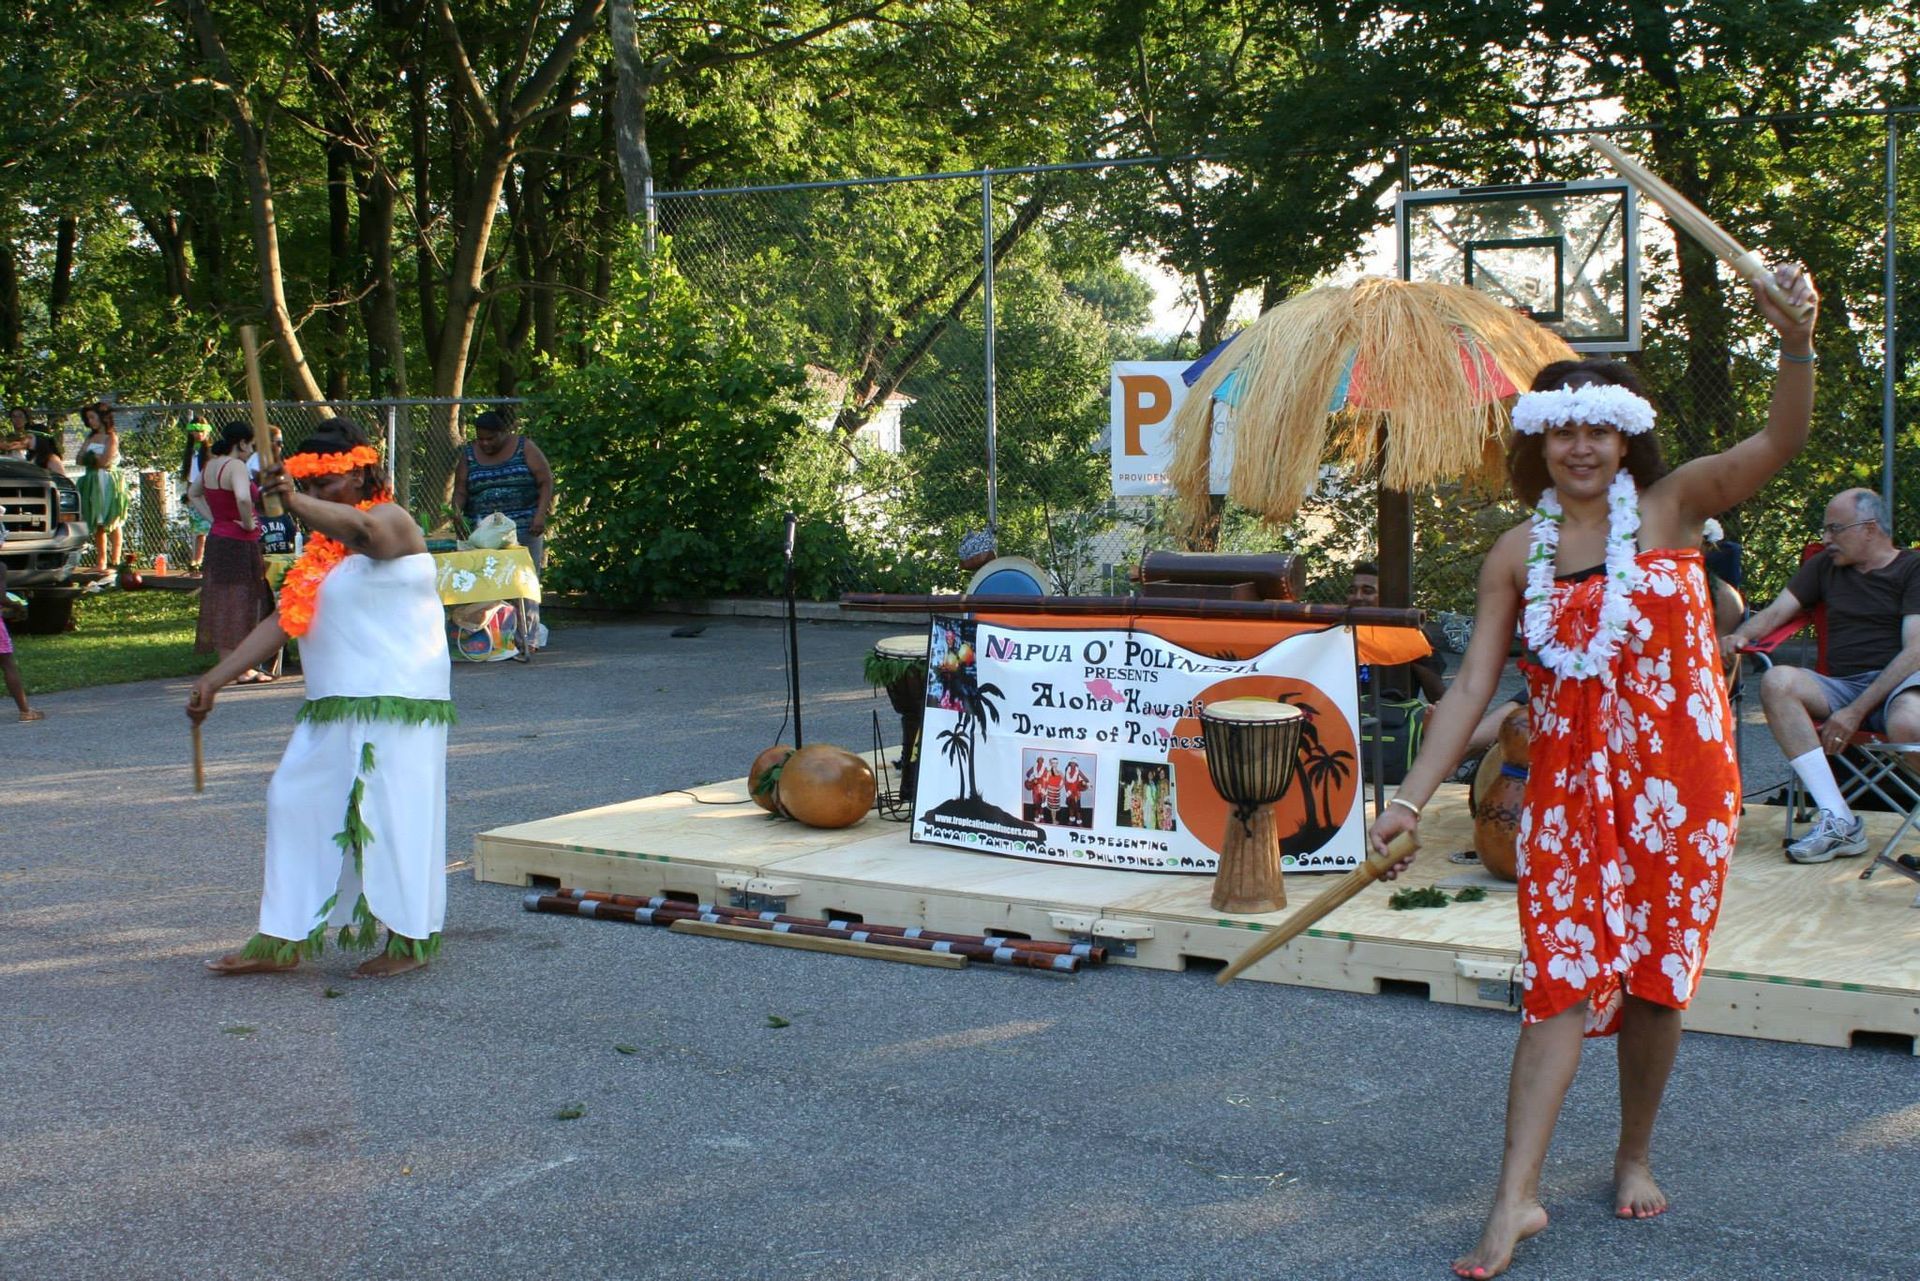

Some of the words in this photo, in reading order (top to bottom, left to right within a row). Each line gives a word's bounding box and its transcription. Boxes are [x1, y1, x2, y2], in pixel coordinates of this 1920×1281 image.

[1119, 473, 1168, 481] PROVIDEN
[985, 635, 1072, 662] NAPUA
[1083, 640, 1113, 665] O'
[1124, 641, 1259, 674] POLYNESIA
[1084, 666, 1158, 683] PRESENTS
[1031, 682, 1114, 712] Aloha
[1123, 689, 1204, 719] Hawaii
[1012, 713, 1088, 741] Drums
[1096, 727, 1119, 742] of
[1124, 721, 1206, 753] Polynes
[923, 826, 966, 843] HAWAII
[978, 836, 1013, 851] TAHITI
[1086, 850, 1163, 867] PHILIPPINES
[1181, 857, 1216, 868] MAR
[1299, 855, 1356, 866] SAMOA
[1069, 831, 1168, 851] REPRESENTING
